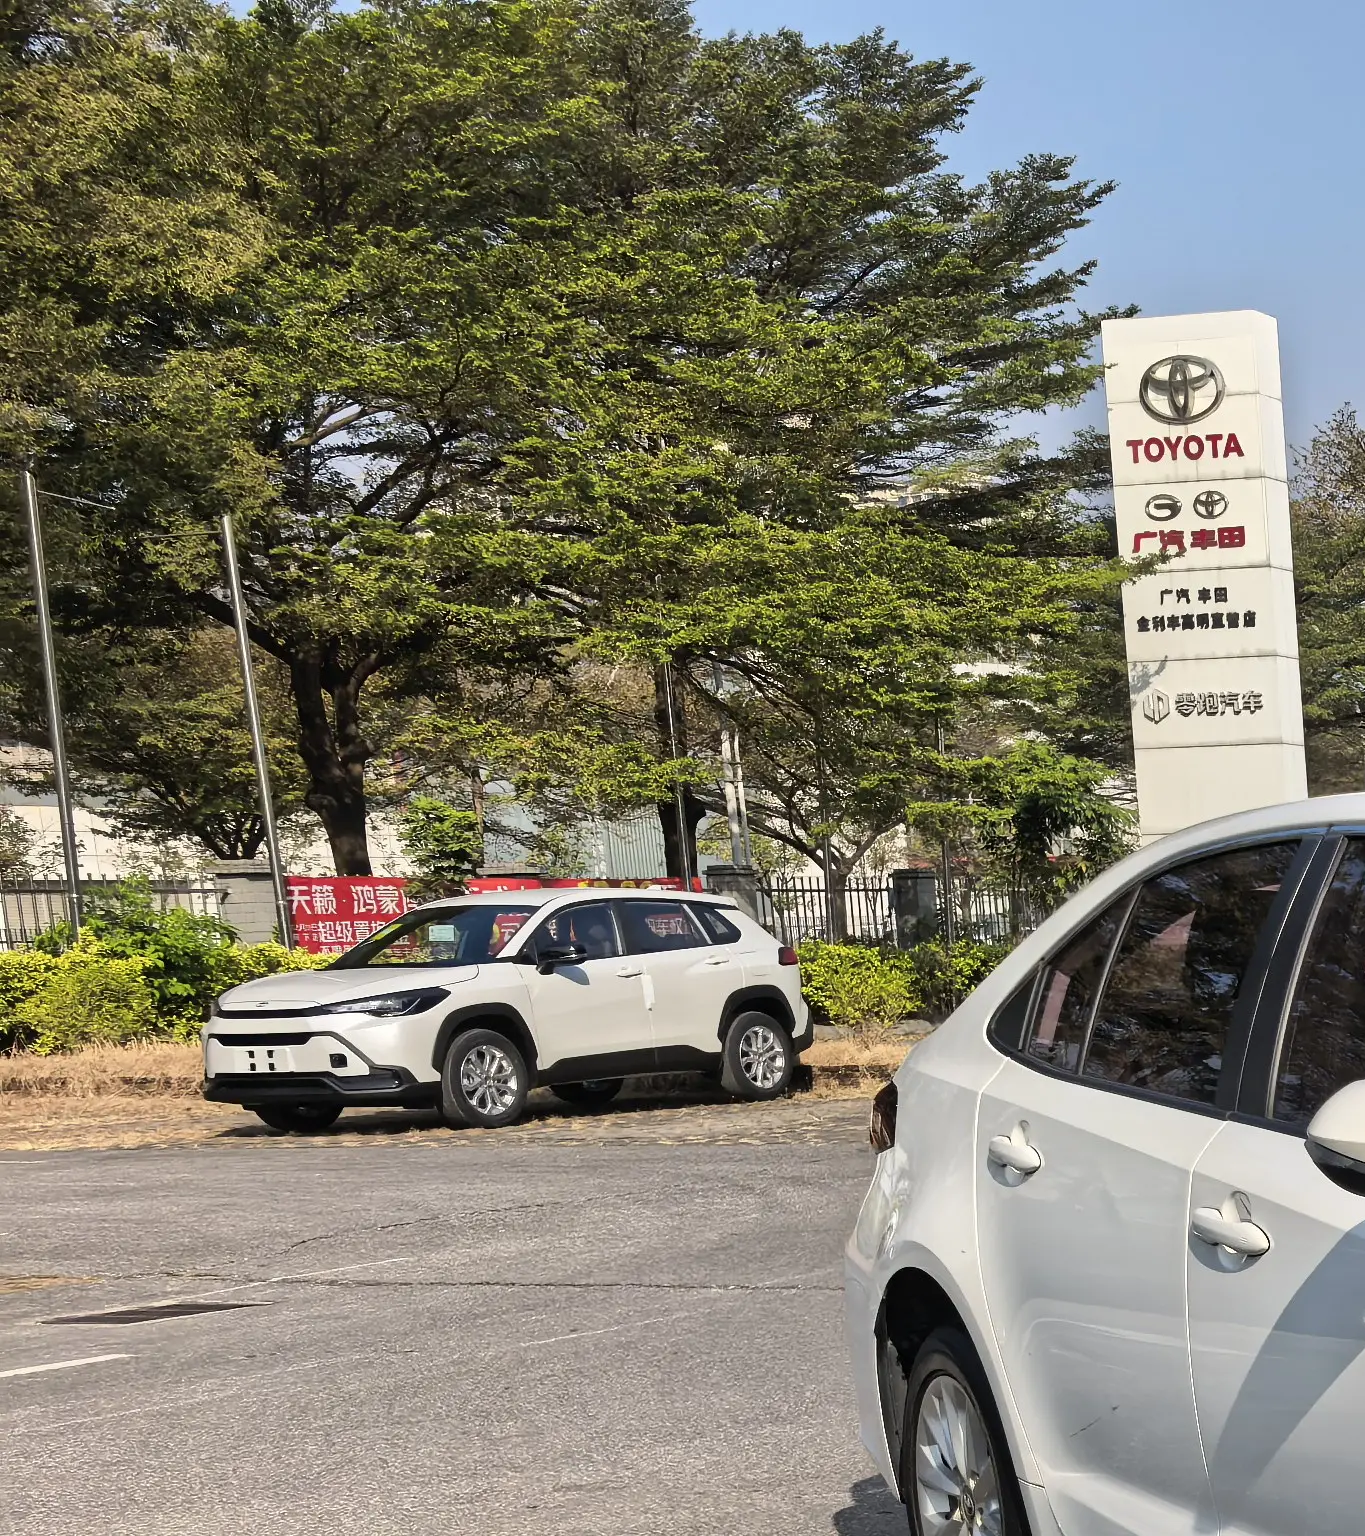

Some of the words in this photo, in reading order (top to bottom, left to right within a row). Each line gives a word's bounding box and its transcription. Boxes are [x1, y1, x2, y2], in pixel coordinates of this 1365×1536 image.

[1126, 433, 1244, 463] TOYOTA
[1132, 526, 1246, 554] 广汽丰田
[1175, 691, 1264, 717] 零跑汽车
